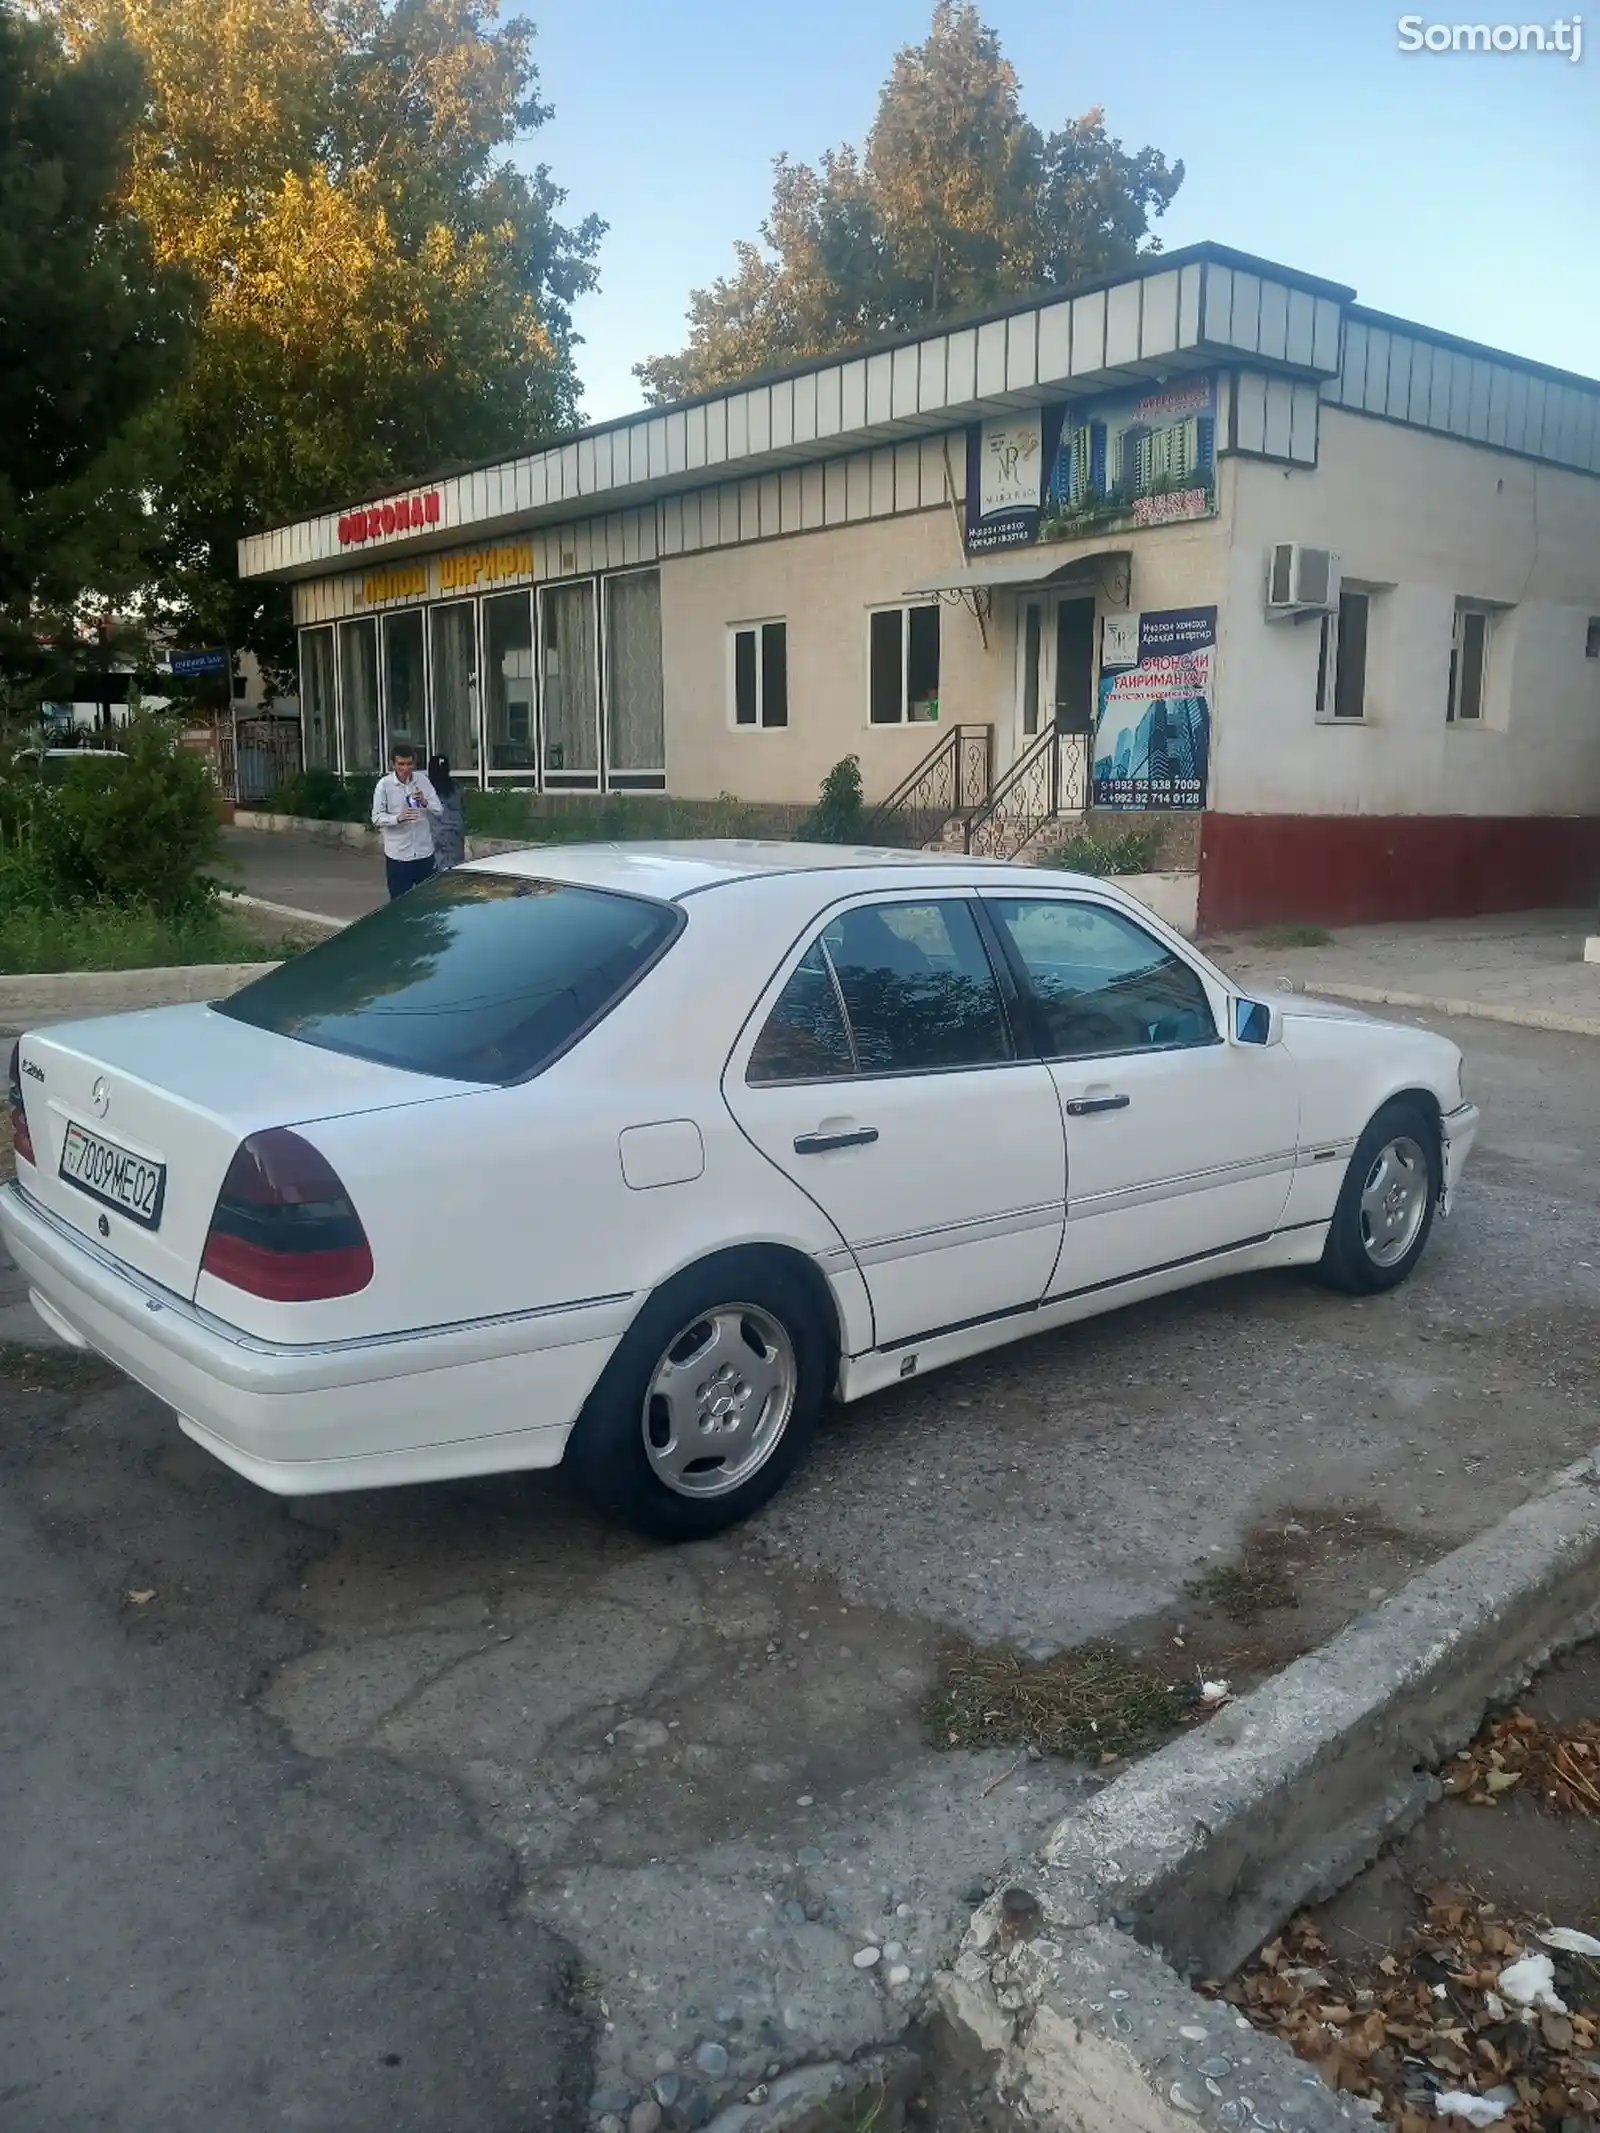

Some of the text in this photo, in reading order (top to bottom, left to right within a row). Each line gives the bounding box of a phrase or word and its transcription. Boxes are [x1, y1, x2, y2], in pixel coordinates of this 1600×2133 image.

[1108, 779, 1201, 790] +992 92 938 7009
[1108, 793, 1200, 804] +992 92 714 0128
[76, 1136, 156, 1213] 7009ME02
